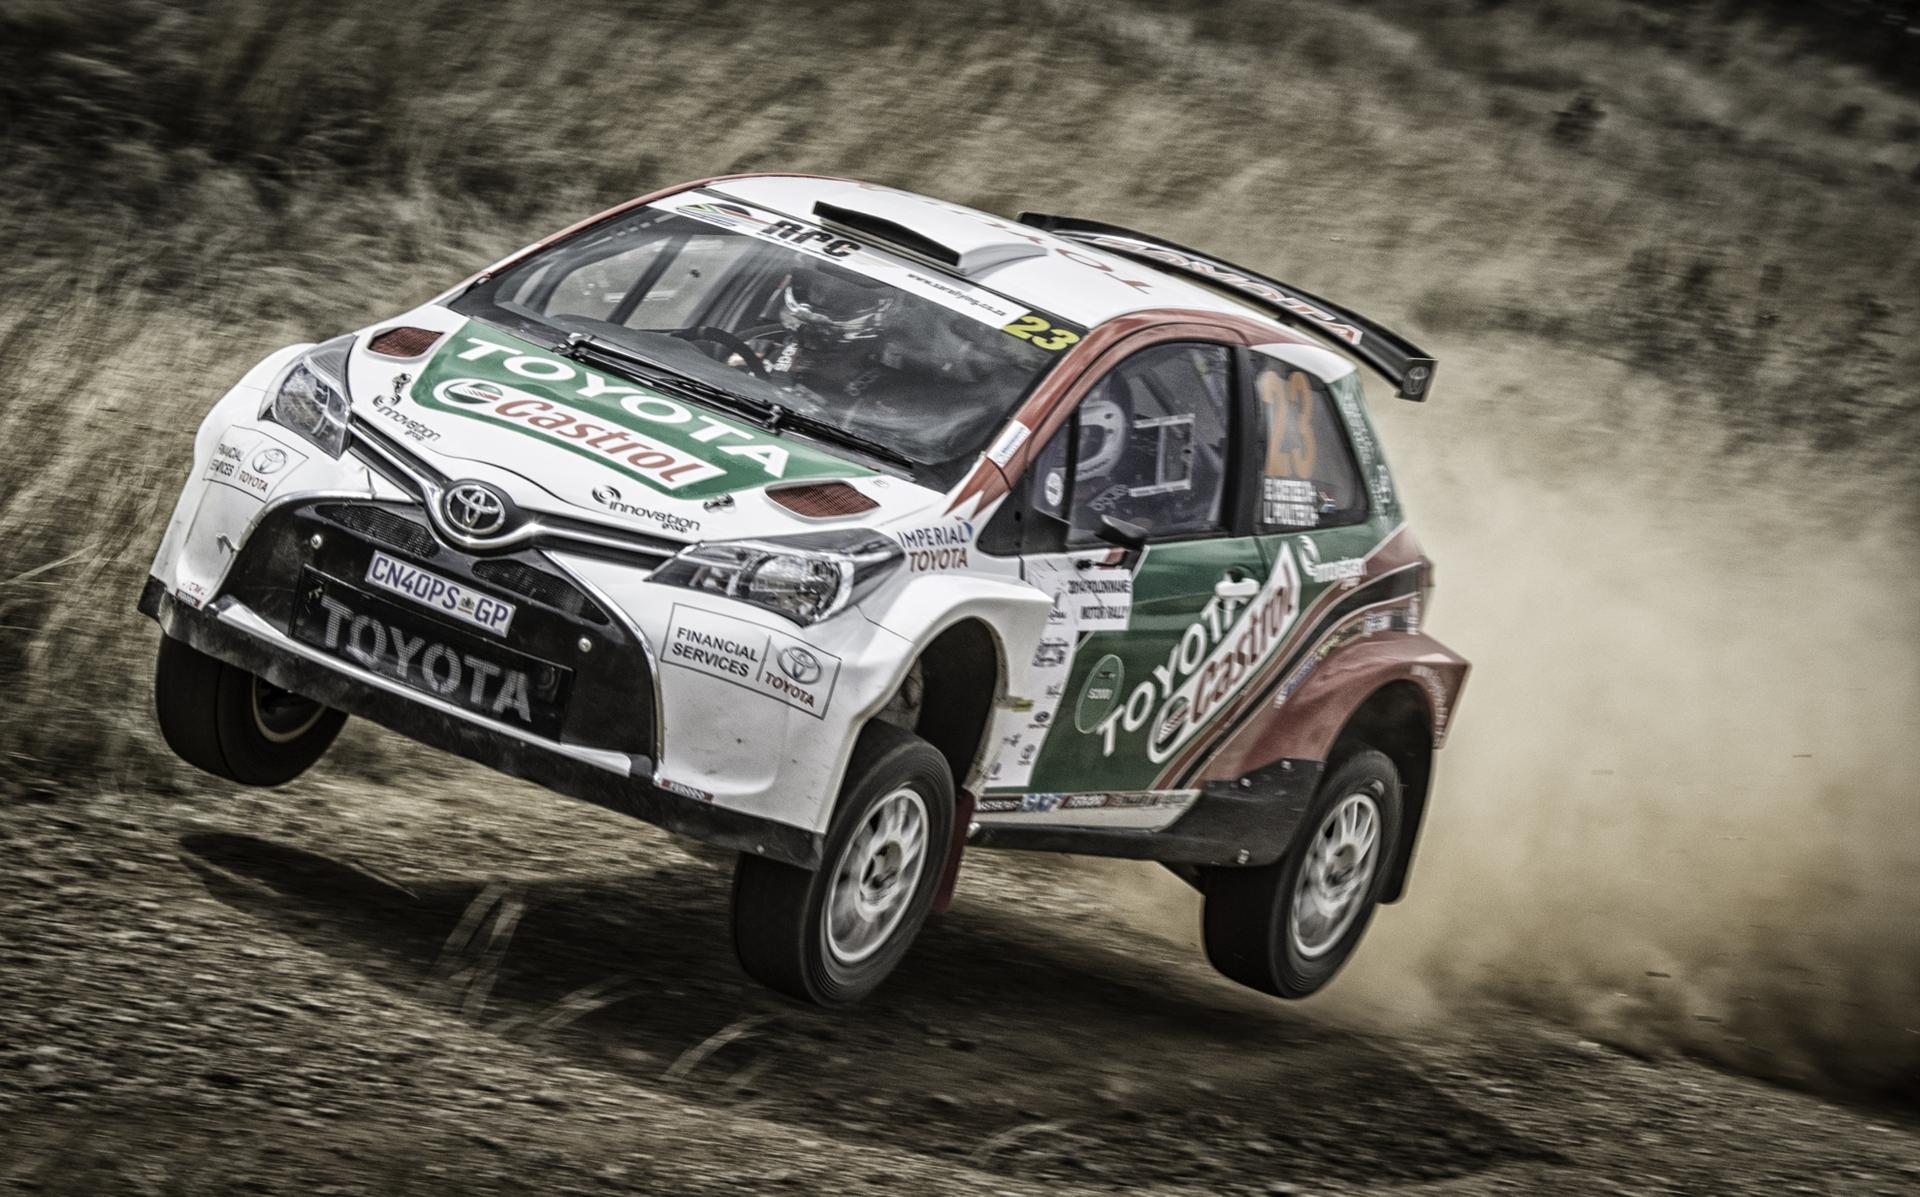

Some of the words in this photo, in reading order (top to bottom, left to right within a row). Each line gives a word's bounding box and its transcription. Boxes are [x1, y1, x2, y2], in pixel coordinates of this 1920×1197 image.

[1003, 316, 1080, 351] 23
[457, 338, 790, 478] TOYOTA
[1258, 371, 1316, 478] 23
[495, 400, 706, 482] Castrol
[239, 470, 268, 493] TOYOTA
[609, 500, 701, 531] innovation
[897, 525, 969, 548] IMPERIAL
[908, 547, 968, 572] TOYOTA
[474, 598, 509, 627] GP
[319, 597, 532, 722] TOYOTA
[672, 642, 750, 677] SERVICES
[677, 627, 759, 663] FINANCIAL
[1190, 563, 1293, 722] Castrol
[765, 671, 815, 708] TOYOTA
